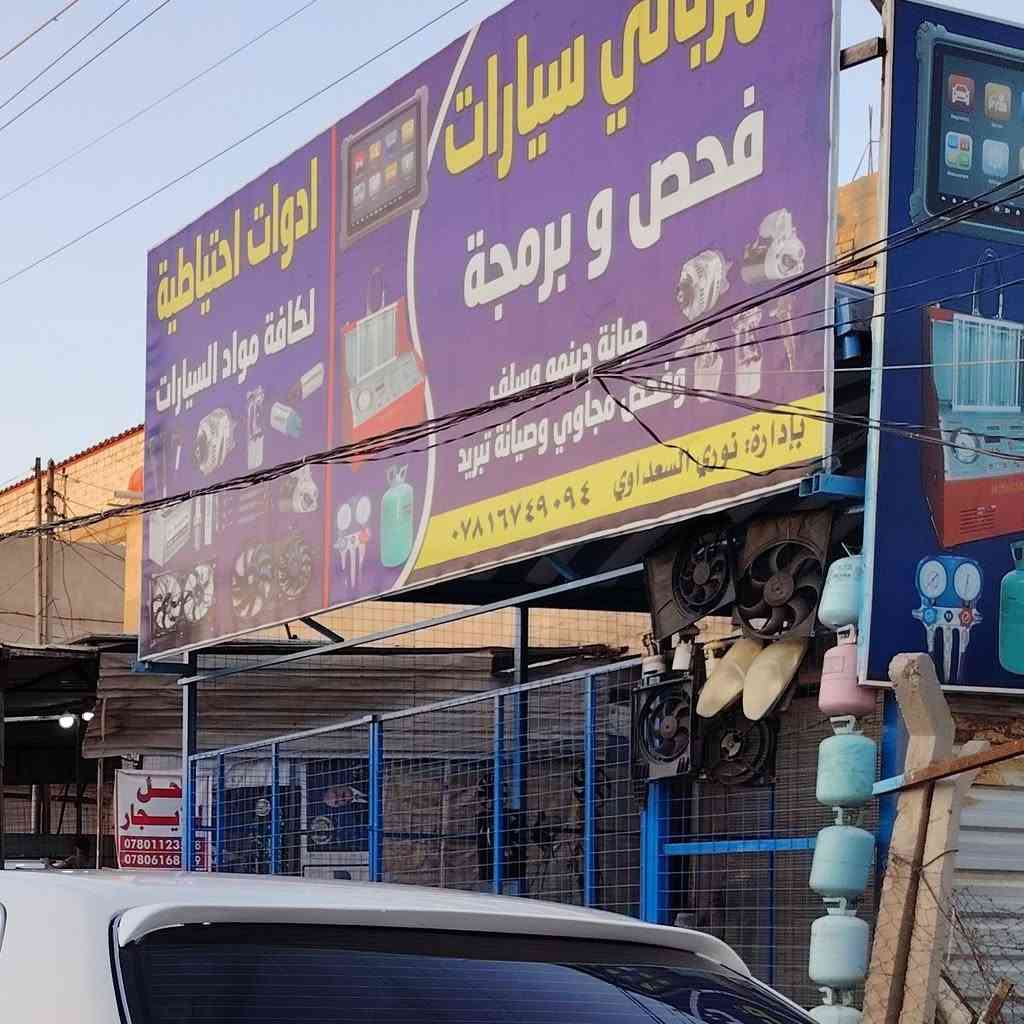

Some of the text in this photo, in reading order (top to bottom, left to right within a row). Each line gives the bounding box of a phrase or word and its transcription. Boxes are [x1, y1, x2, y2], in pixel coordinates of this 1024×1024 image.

[446, 34, 585, 179] سيارات
[464, 85, 764, 321] فحص و برمجة
[157, 157, 318, 335] ادوات احتياطية
[156, 287, 316, 416] لكافة مواد السيارات
[597, 318, 648, 363] صيانة
[458, 432, 491, 480] تبريد
[494, 418, 549, 463] وصيانة
[137, 776, 182, 803] حل
[124, 838, 201, 850] 078011238
[124, 854, 201, 866] 078061689
